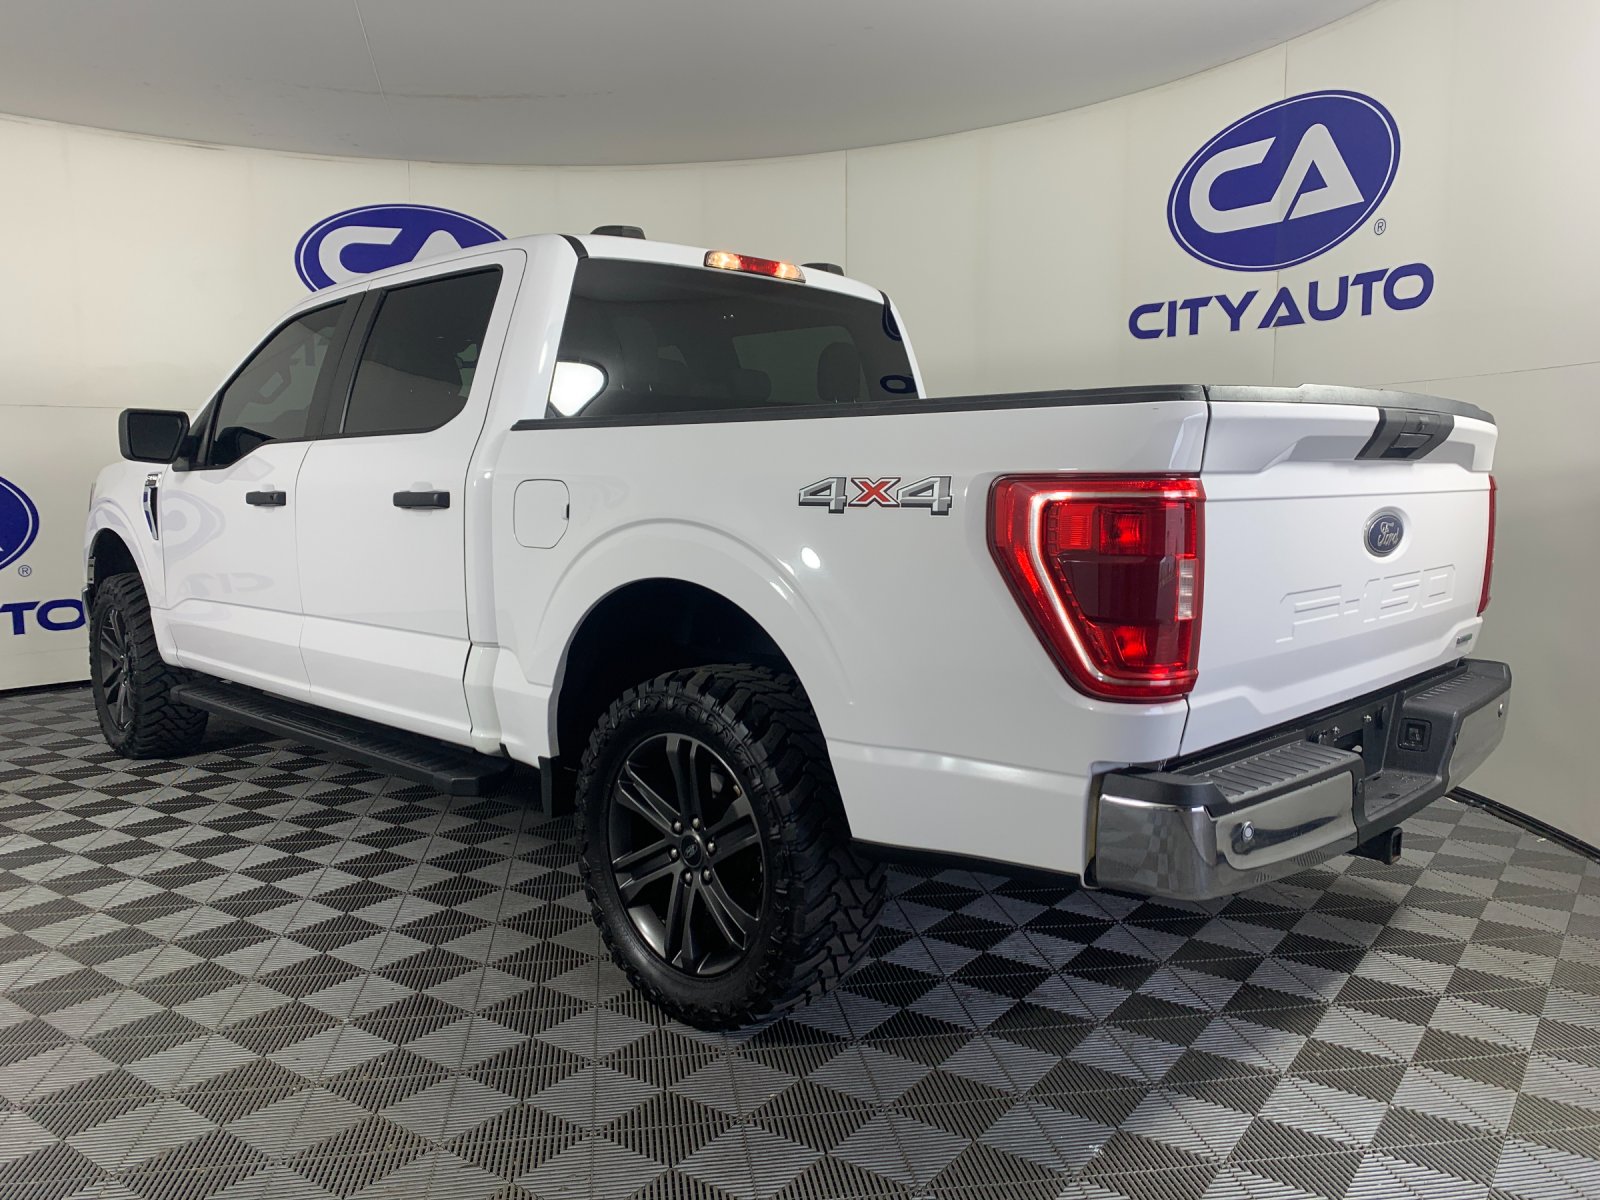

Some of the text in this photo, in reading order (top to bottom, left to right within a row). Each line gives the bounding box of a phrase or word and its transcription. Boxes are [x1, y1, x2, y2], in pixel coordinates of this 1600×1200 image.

[1189, 123, 1365, 234] CA
[1128, 262, 1434, 340] CITY AUTO
[1377, 521, 1400, 547] Ford
[1275, 564, 1456, 643] F-150
